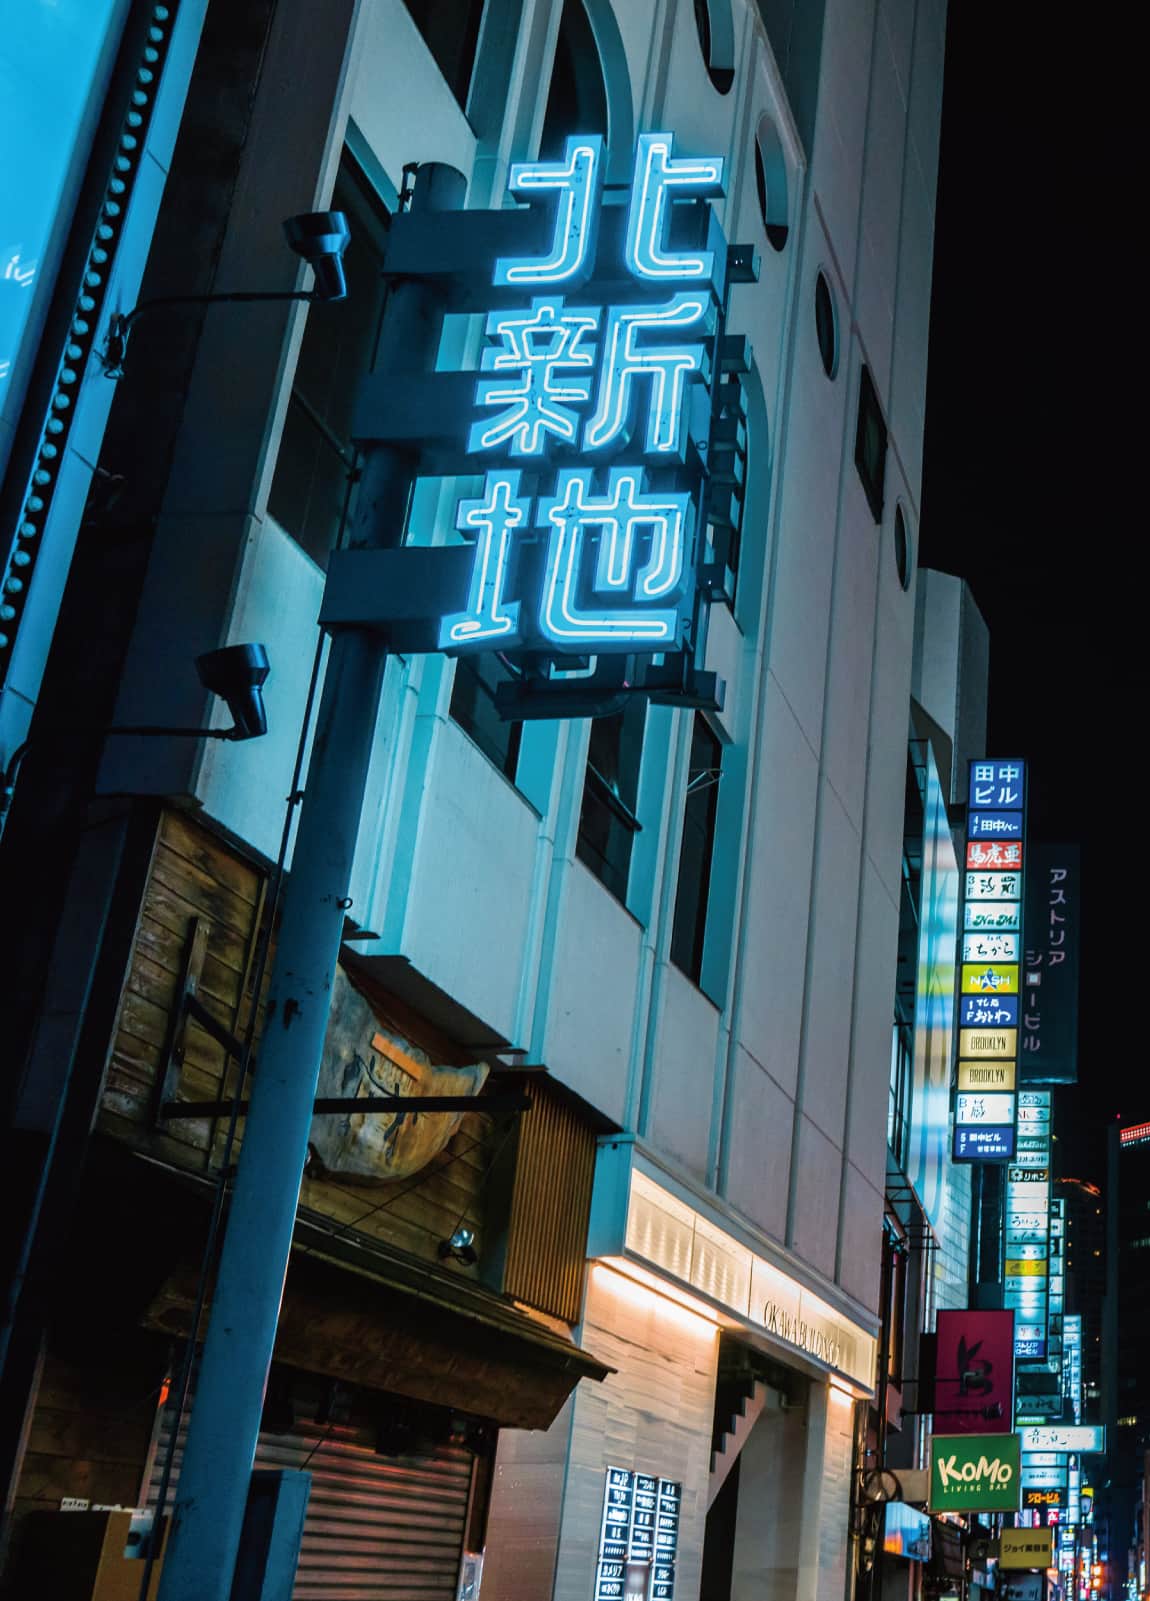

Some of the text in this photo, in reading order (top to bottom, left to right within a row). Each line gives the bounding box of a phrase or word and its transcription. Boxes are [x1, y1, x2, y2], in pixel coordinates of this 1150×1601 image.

[438, 131, 725, 655] 北新地
[975, 764, 1020, 783] 田中
[975, 786, 1018, 805] ビル
[1049, 867, 1068, 967] アストリア
[969, 974, 1011, 986] NASH
[970, 1036, 1007, 1051] BROOKLYN
[969, 1068, 1005, 1083] BROOKLYN
[937, 1454, 1013, 1487] KoMo
